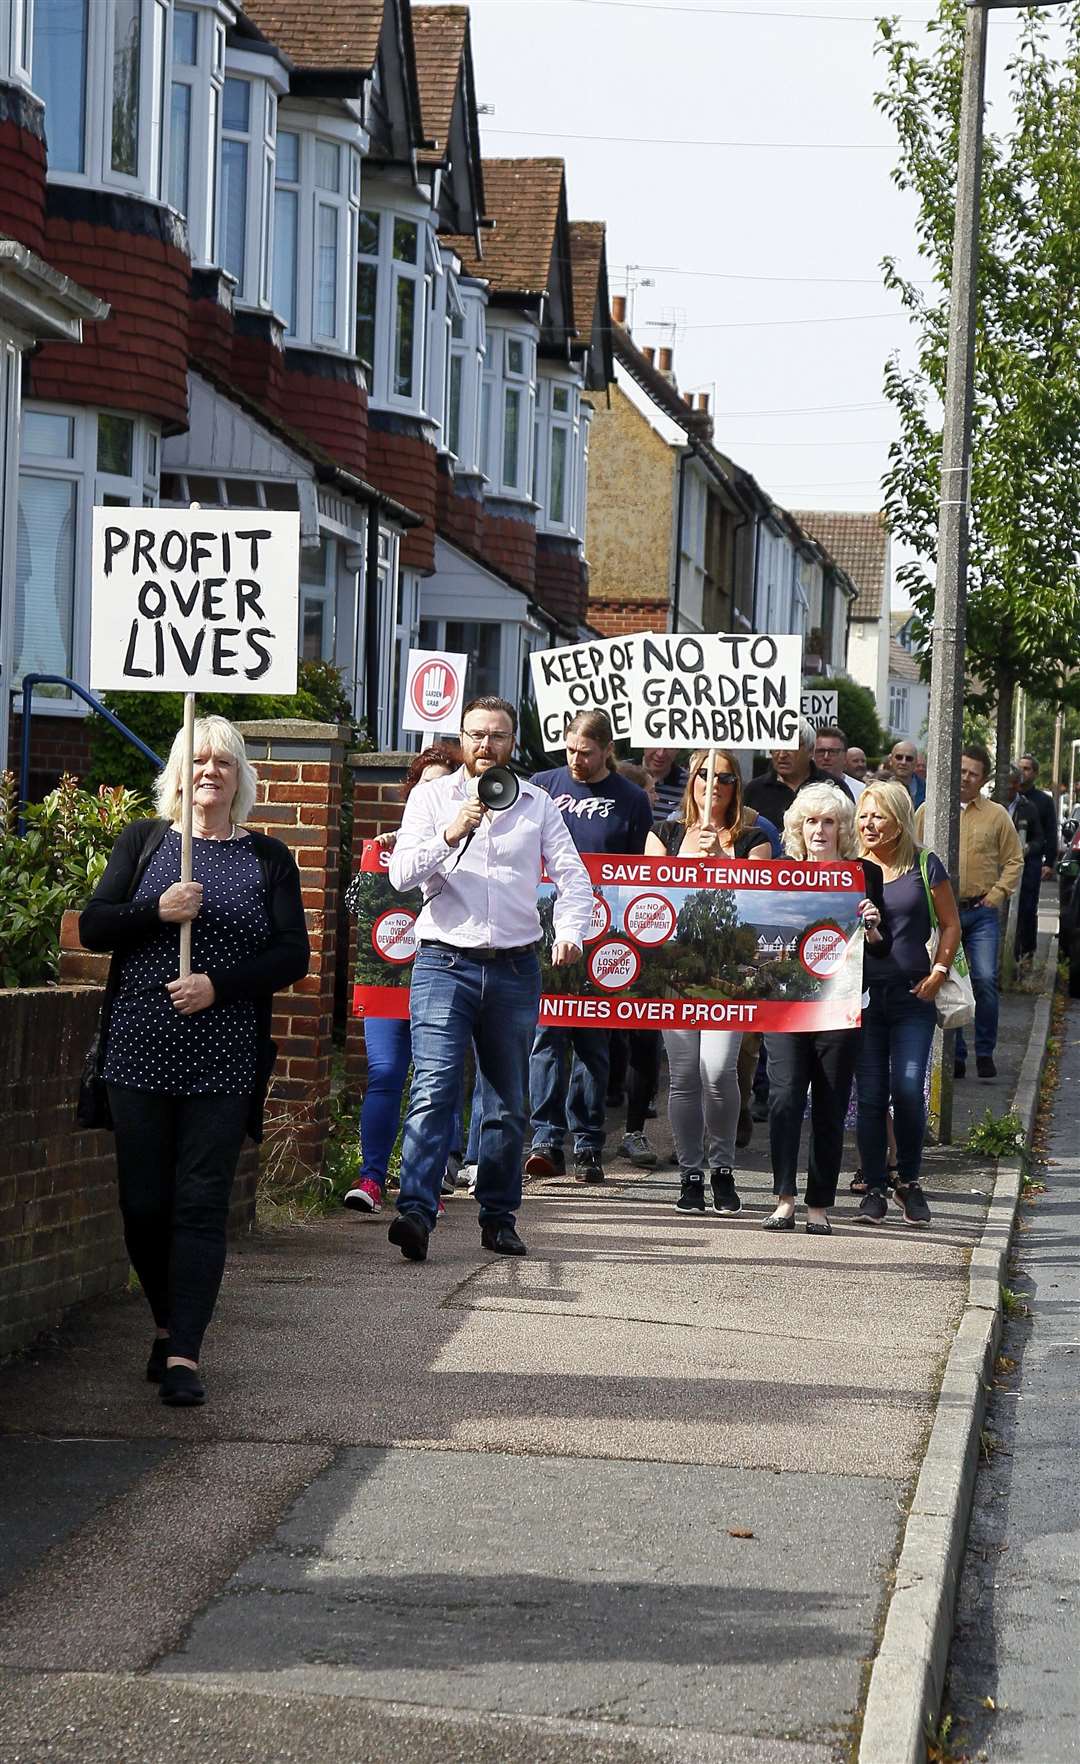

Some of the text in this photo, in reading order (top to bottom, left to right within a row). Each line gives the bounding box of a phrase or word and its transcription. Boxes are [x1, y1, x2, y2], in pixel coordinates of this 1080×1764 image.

[104, 527, 272, 577] PROFIT
[138, 578, 266, 622] OVER
[123, 618, 276, 680] LIVES
[643, 636, 778, 673] NO TO
[541, 646, 604, 686] KEEP
[425, 690, 442, 698] GARDEN
[569, 673, 629, 706] OUR
[642, 674, 787, 708] GARDEN
[644, 708, 798, 743] GRABBING
[601, 863, 853, 887] SAVE OUR TENNIS COURTS
[629, 920, 670, 929] DEVELOPMENT
[635, 912, 666, 920] BACKLAND
[814, 944, 837, 952] HABITAT
[597, 966, 631, 975] PRIVACY
[598, 958, 631, 967] LOSS OF
[616, 1001, 675, 1020] OVER
[682, 1003, 758, 1022] PROFIT
